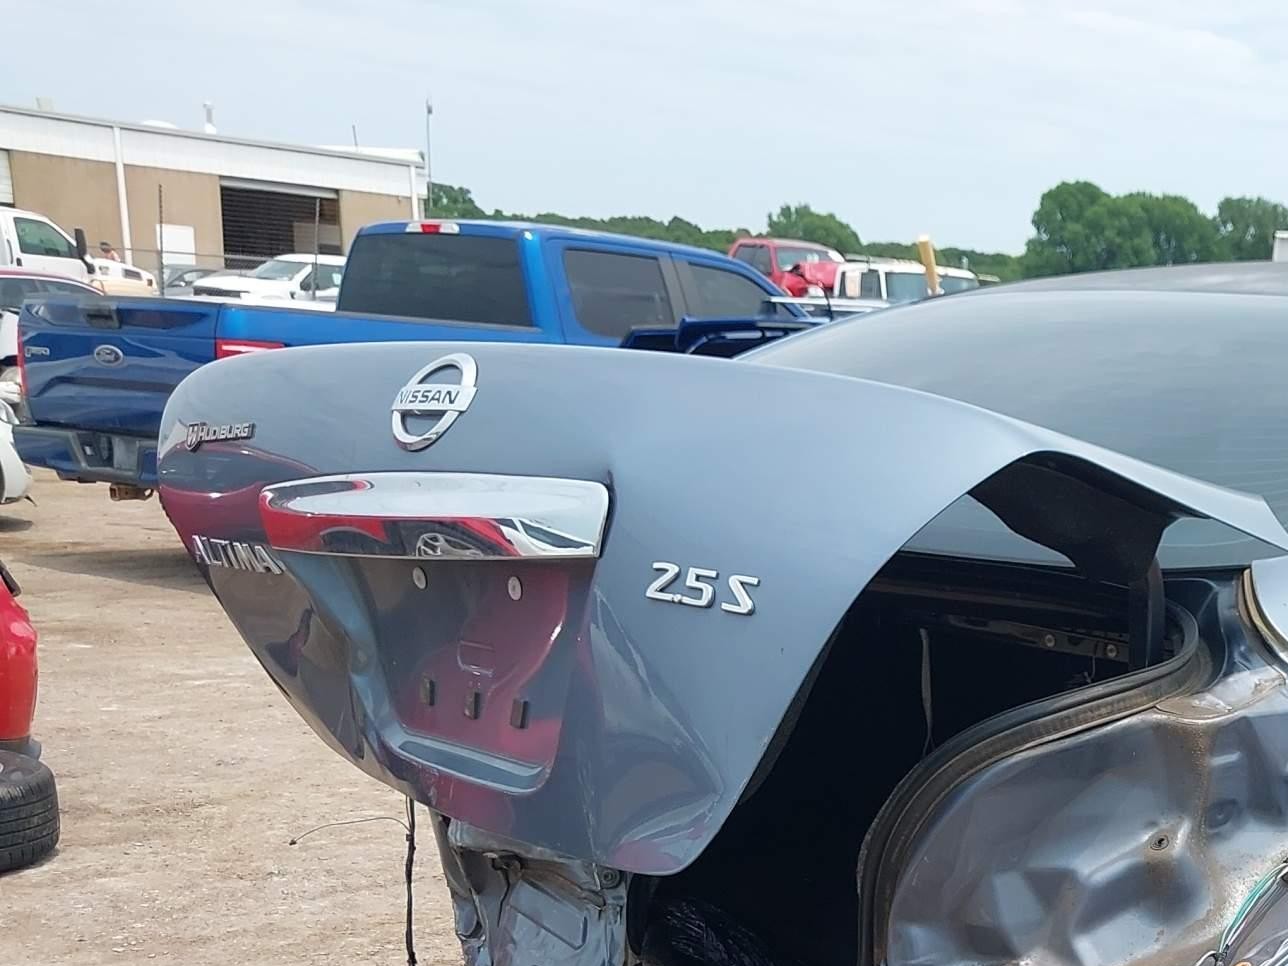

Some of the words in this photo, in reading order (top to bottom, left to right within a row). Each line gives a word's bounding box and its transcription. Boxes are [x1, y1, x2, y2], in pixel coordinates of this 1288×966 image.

[399, 389, 460, 405] NISSAN
[192, 535, 283, 575] ALTIMA
[645, 561, 719, 608] 2.5
[720, 574, 760, 615] S
